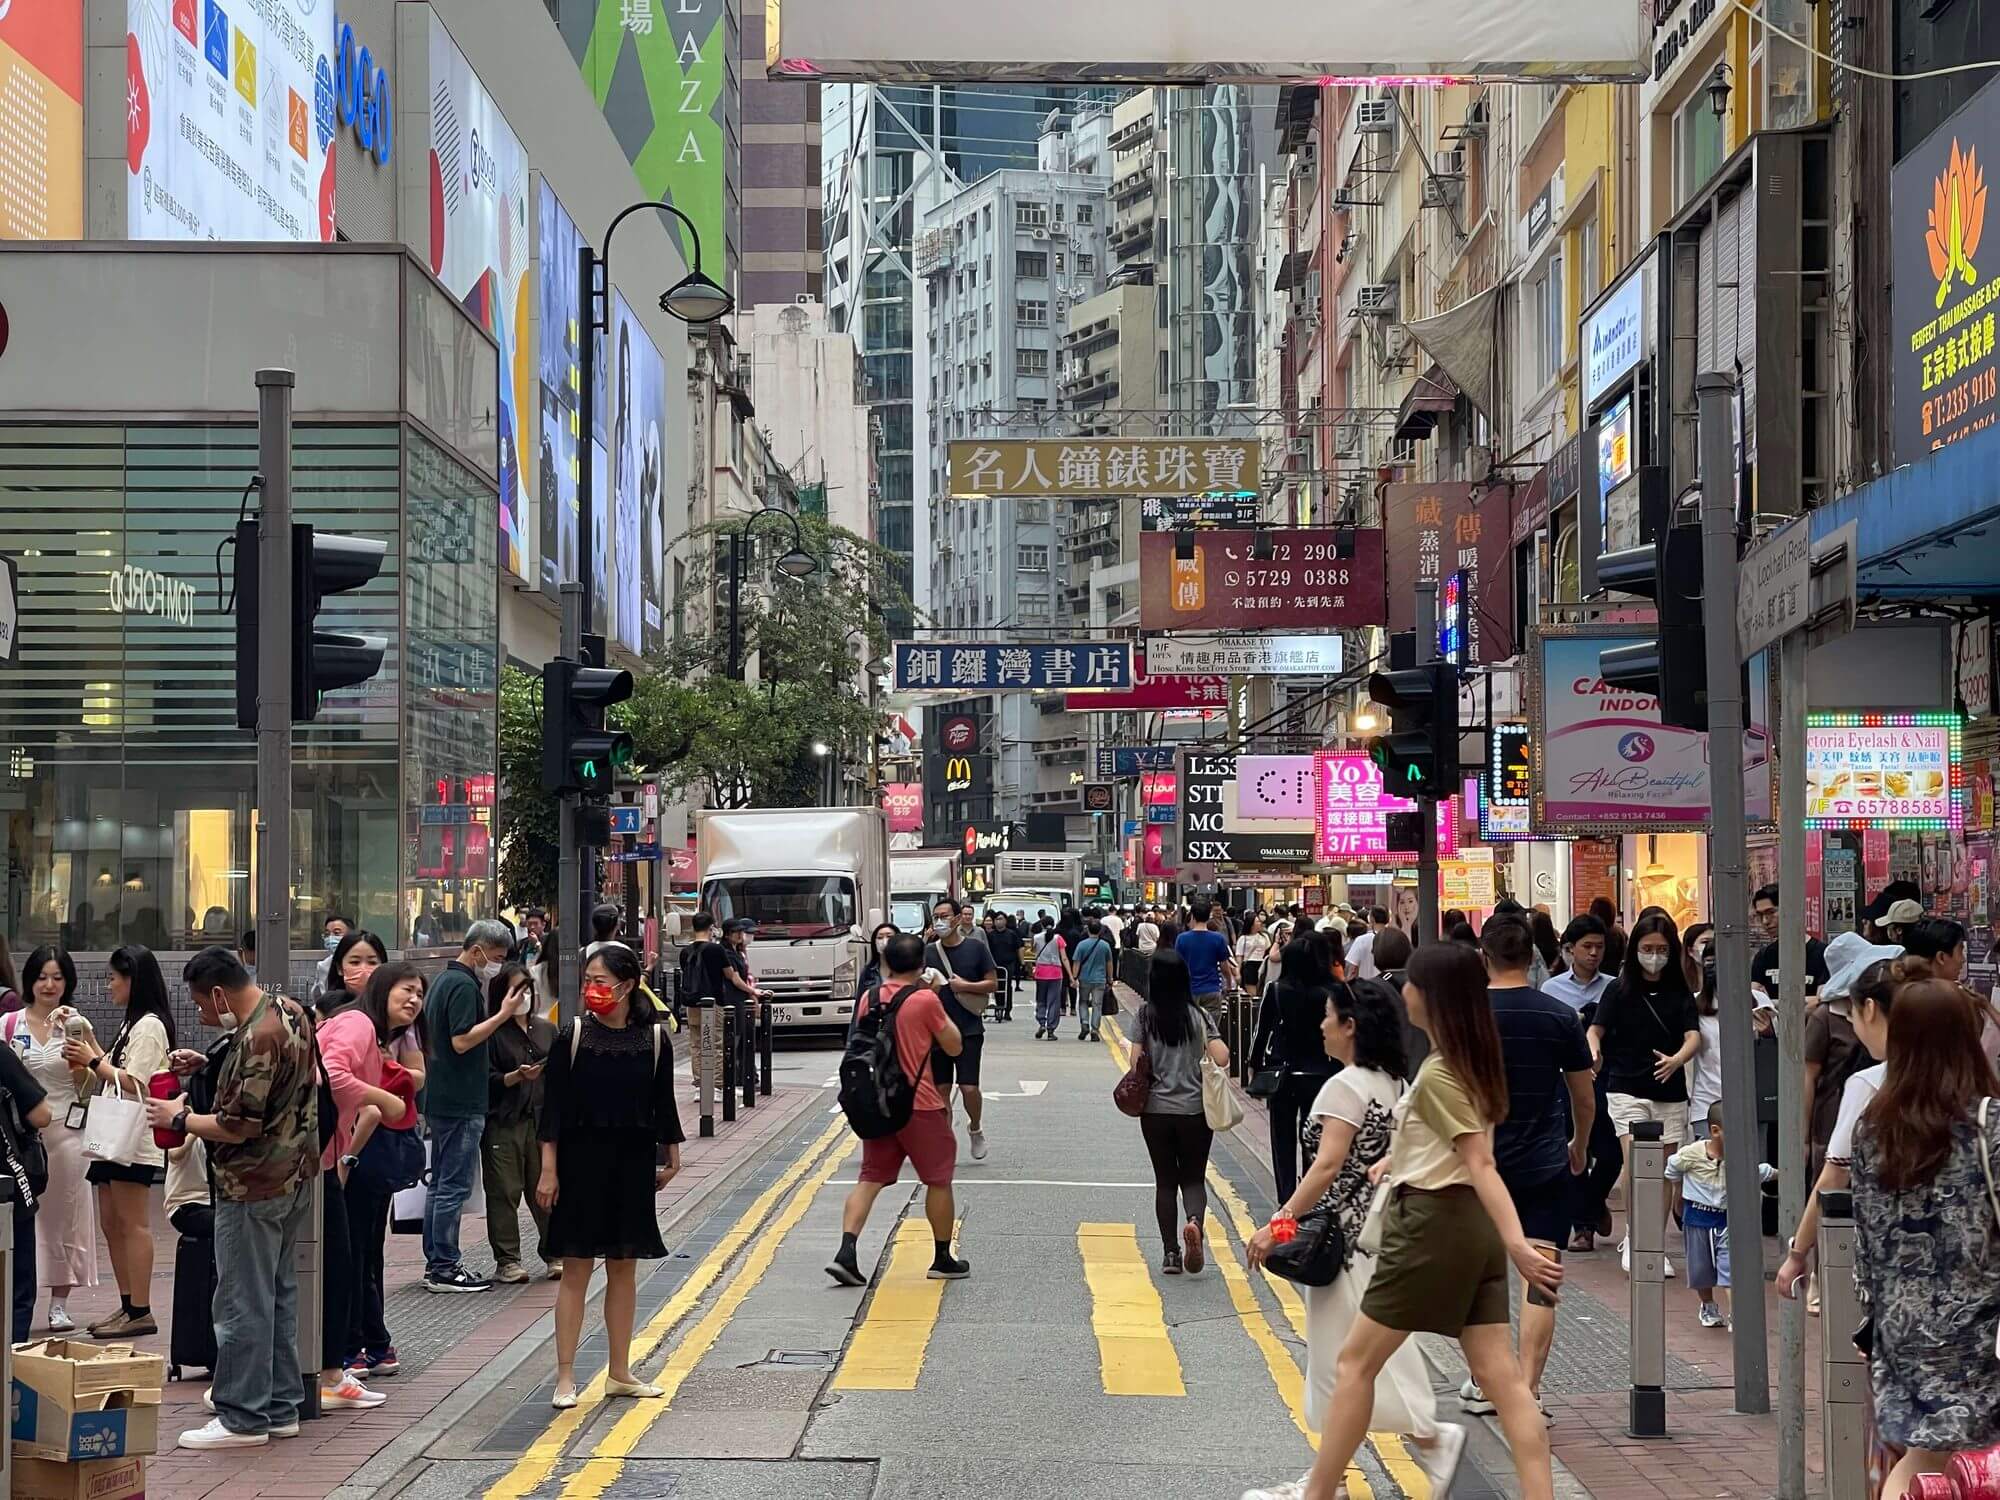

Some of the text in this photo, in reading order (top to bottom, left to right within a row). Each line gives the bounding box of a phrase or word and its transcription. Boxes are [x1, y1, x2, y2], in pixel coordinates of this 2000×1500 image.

[620, 0, 653, 34] 場
[335, 14, 392, 167] OGO
[1911, 319, 1937, 353] PERFECT
[1939, 308, 1953, 335] THAI
[1953, 287, 1986, 325] MASSAGE
[1921, 311, 1996, 392] 正宗泰式按摩
[1972, 366, 1997, 408] 9118
[962, 444, 1248, 492] 名人鐘錶珠寶
[1415, 496, 1443, 527] 藏
[1455, 512, 1481, 545] 傳
[1246, 545, 1347, 561] 272 290
[1757, 535, 1808, 591] Lockhart Road
[1246, 569, 1350, 588] 5729 0388
[1155, 643, 1169, 652] 1/F
[1217, 638, 1257, 647] OMAKASE
[906, 646, 1122, 685] 銅鑼灣書店
[1180, 651, 1320, 665] 情趣用品香港旗艦店
[1848, 732, 1897, 751] Eyelash
[1901, 735, 1911, 748] &
[1915, 733, 1940, 748] Nail
[886, 795, 919, 806] sasa
[1189, 785, 1223, 803] ST
[1329, 783, 1381, 801] 美容
[893, 807, 911, 816] 莎莎
[1556, 812, 1590, 821] Contact
[1598, 812, 1620, 820] +852
[1621, 812, 1643, 820] 9134
[1857, 800, 1943, 815] 65788585
[1188, 842, 1231, 860] SEX
[1328, 834, 1360, 852] 3/F
[1260, 848, 1310, 857] OMAKASE TOY
[773, 1007, 785, 1015] MK
[773, 1015, 792, 1023] 779
[6, 1153, 34, 1207] UNIVERSE
